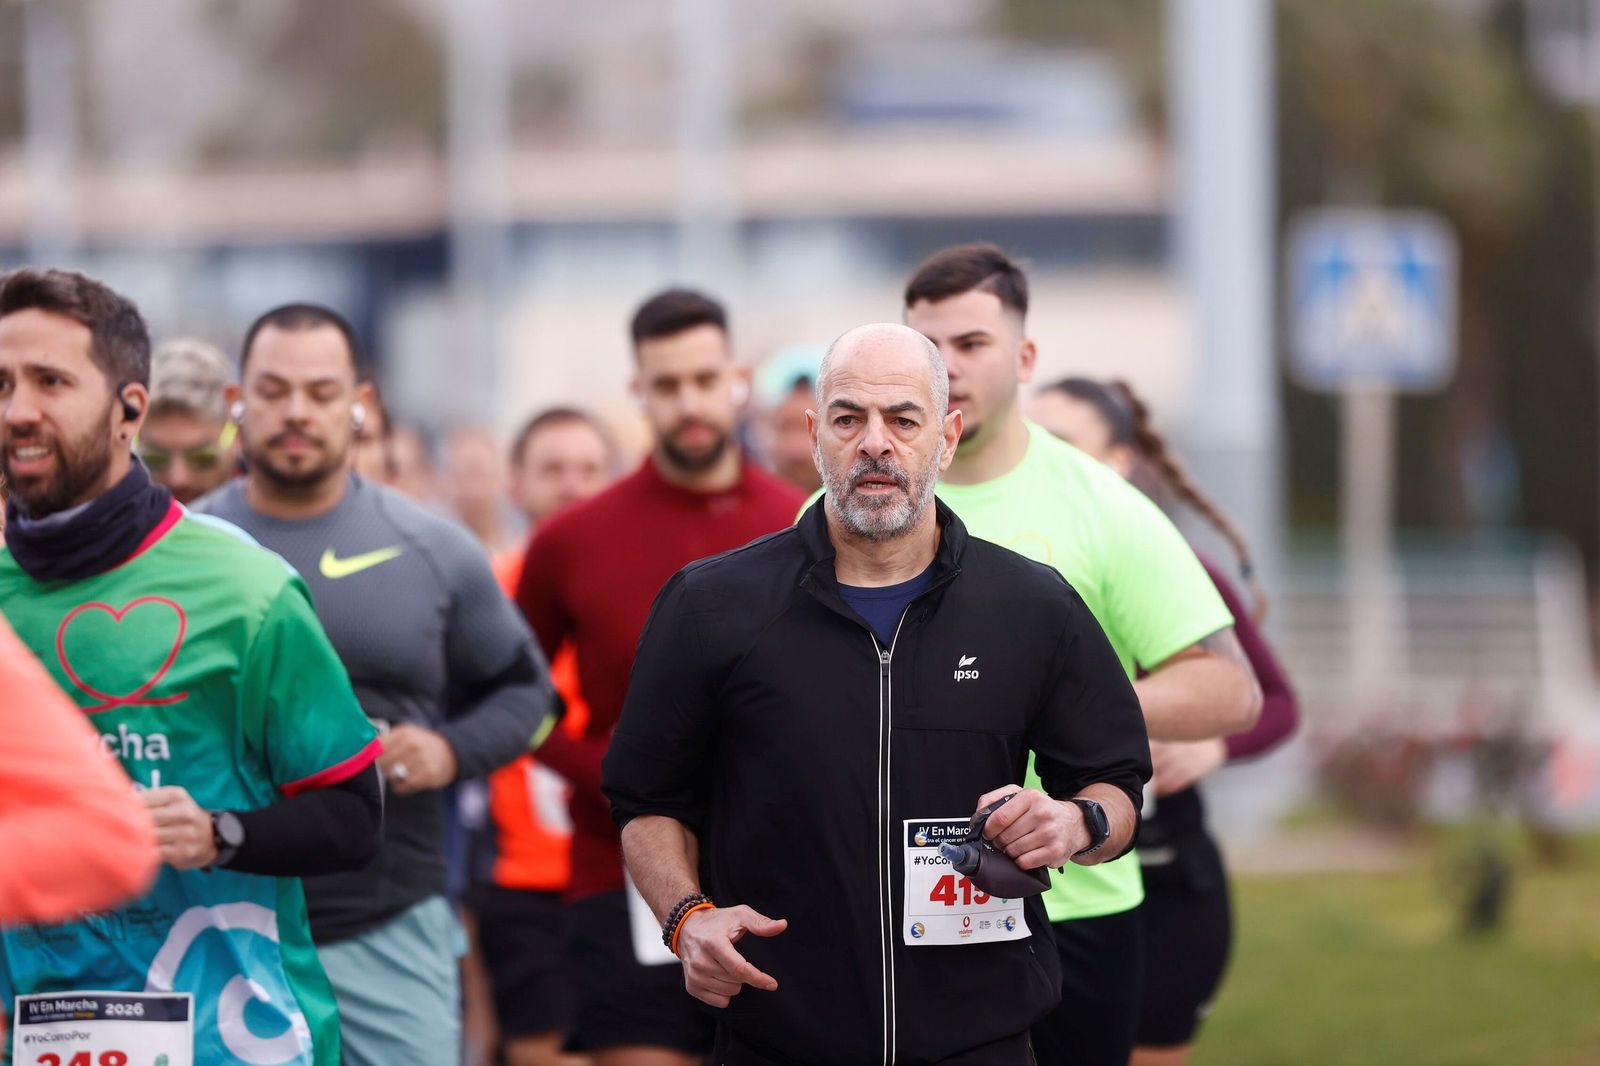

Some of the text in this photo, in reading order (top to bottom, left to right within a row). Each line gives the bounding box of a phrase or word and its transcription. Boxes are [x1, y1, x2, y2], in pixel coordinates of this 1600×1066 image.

[953, 670, 979, 682] ipso
[101, 723, 170, 761] cha
[931, 826, 945, 836] En
[946, 826, 971, 836] Marc
[914, 855, 950, 866] #YoCo
[40, 1001, 54, 1014] En
[55, 998, 98, 1013] Marcha
[105, 1003, 144, 1016] 2026
